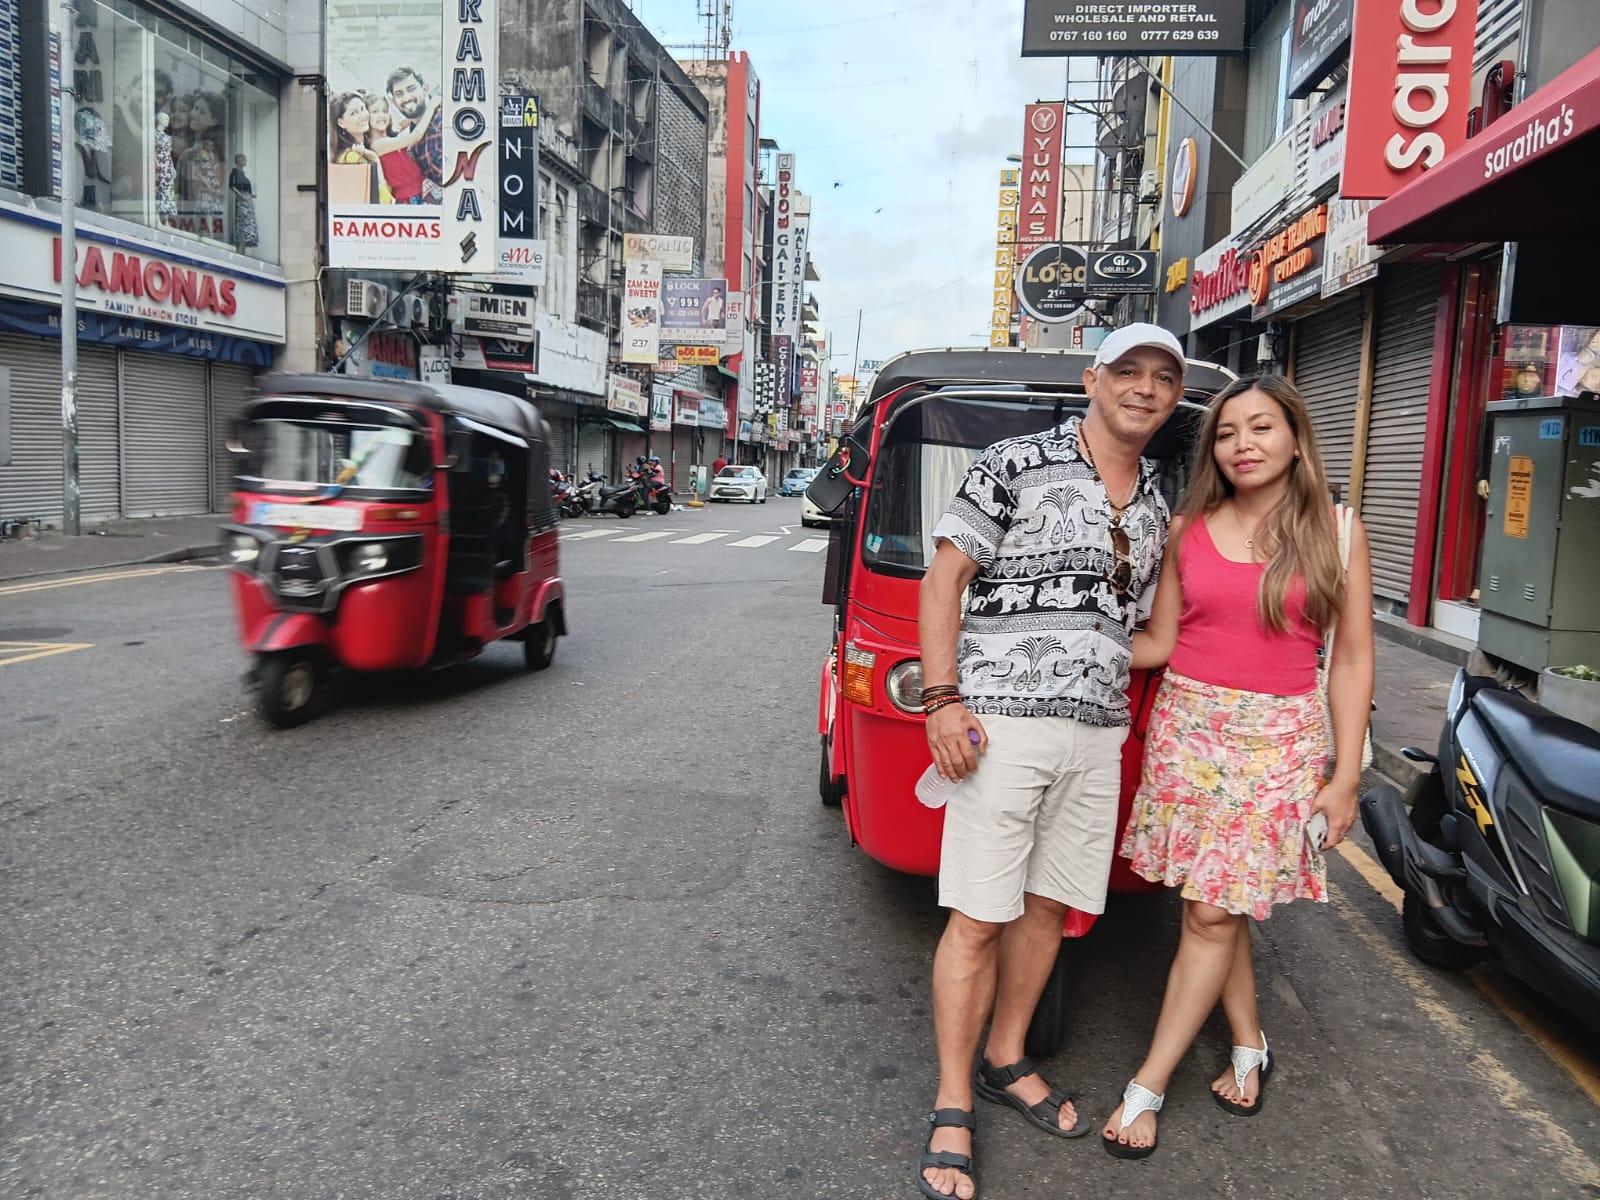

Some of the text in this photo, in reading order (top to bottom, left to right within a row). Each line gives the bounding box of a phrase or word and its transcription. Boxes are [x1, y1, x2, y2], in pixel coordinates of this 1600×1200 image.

[1075, 4, 1197, 14] DIRECT IMPORTER
[1054, 14, 1217, 24] WHOLESALE AND RETAIL
[1050, 30, 1219, 41] 0767 160 160 0777 629 639
[1484, 104, 1574, 178] saratha's
[1028, 137, 1052, 235] YUMNA'S
[333, 221, 441, 238] RAMONAS
[1026, 265, 1086, 284] LOGO
[627, 279, 659, 290] ZAM ZAM
[675, 282, 700, 291] LOCK
[628, 288, 658, 298] SWEETS
[104, 299, 198, 326] FAMILY FASHION STORE
[119, 325, 161, 342] LADIES
[188, 336, 213, 351] KIDS
